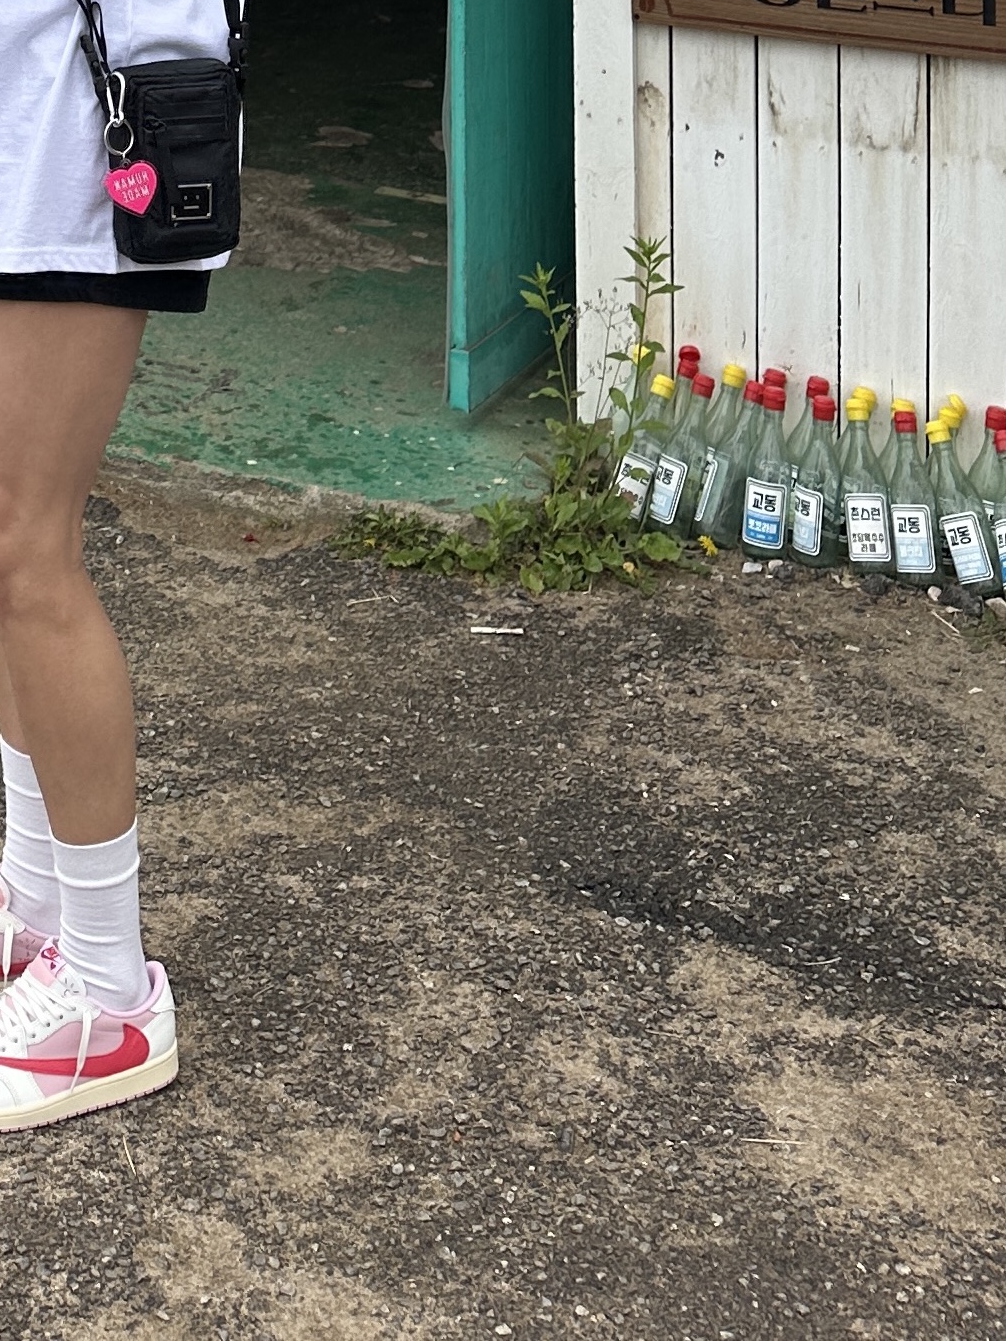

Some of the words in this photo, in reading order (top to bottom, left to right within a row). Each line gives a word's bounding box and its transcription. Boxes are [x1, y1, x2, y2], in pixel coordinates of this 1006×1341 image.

[752, 491, 777, 513] 교동
[897, 517, 921, 534] 교동
[947, 525, 972, 546] 교동
